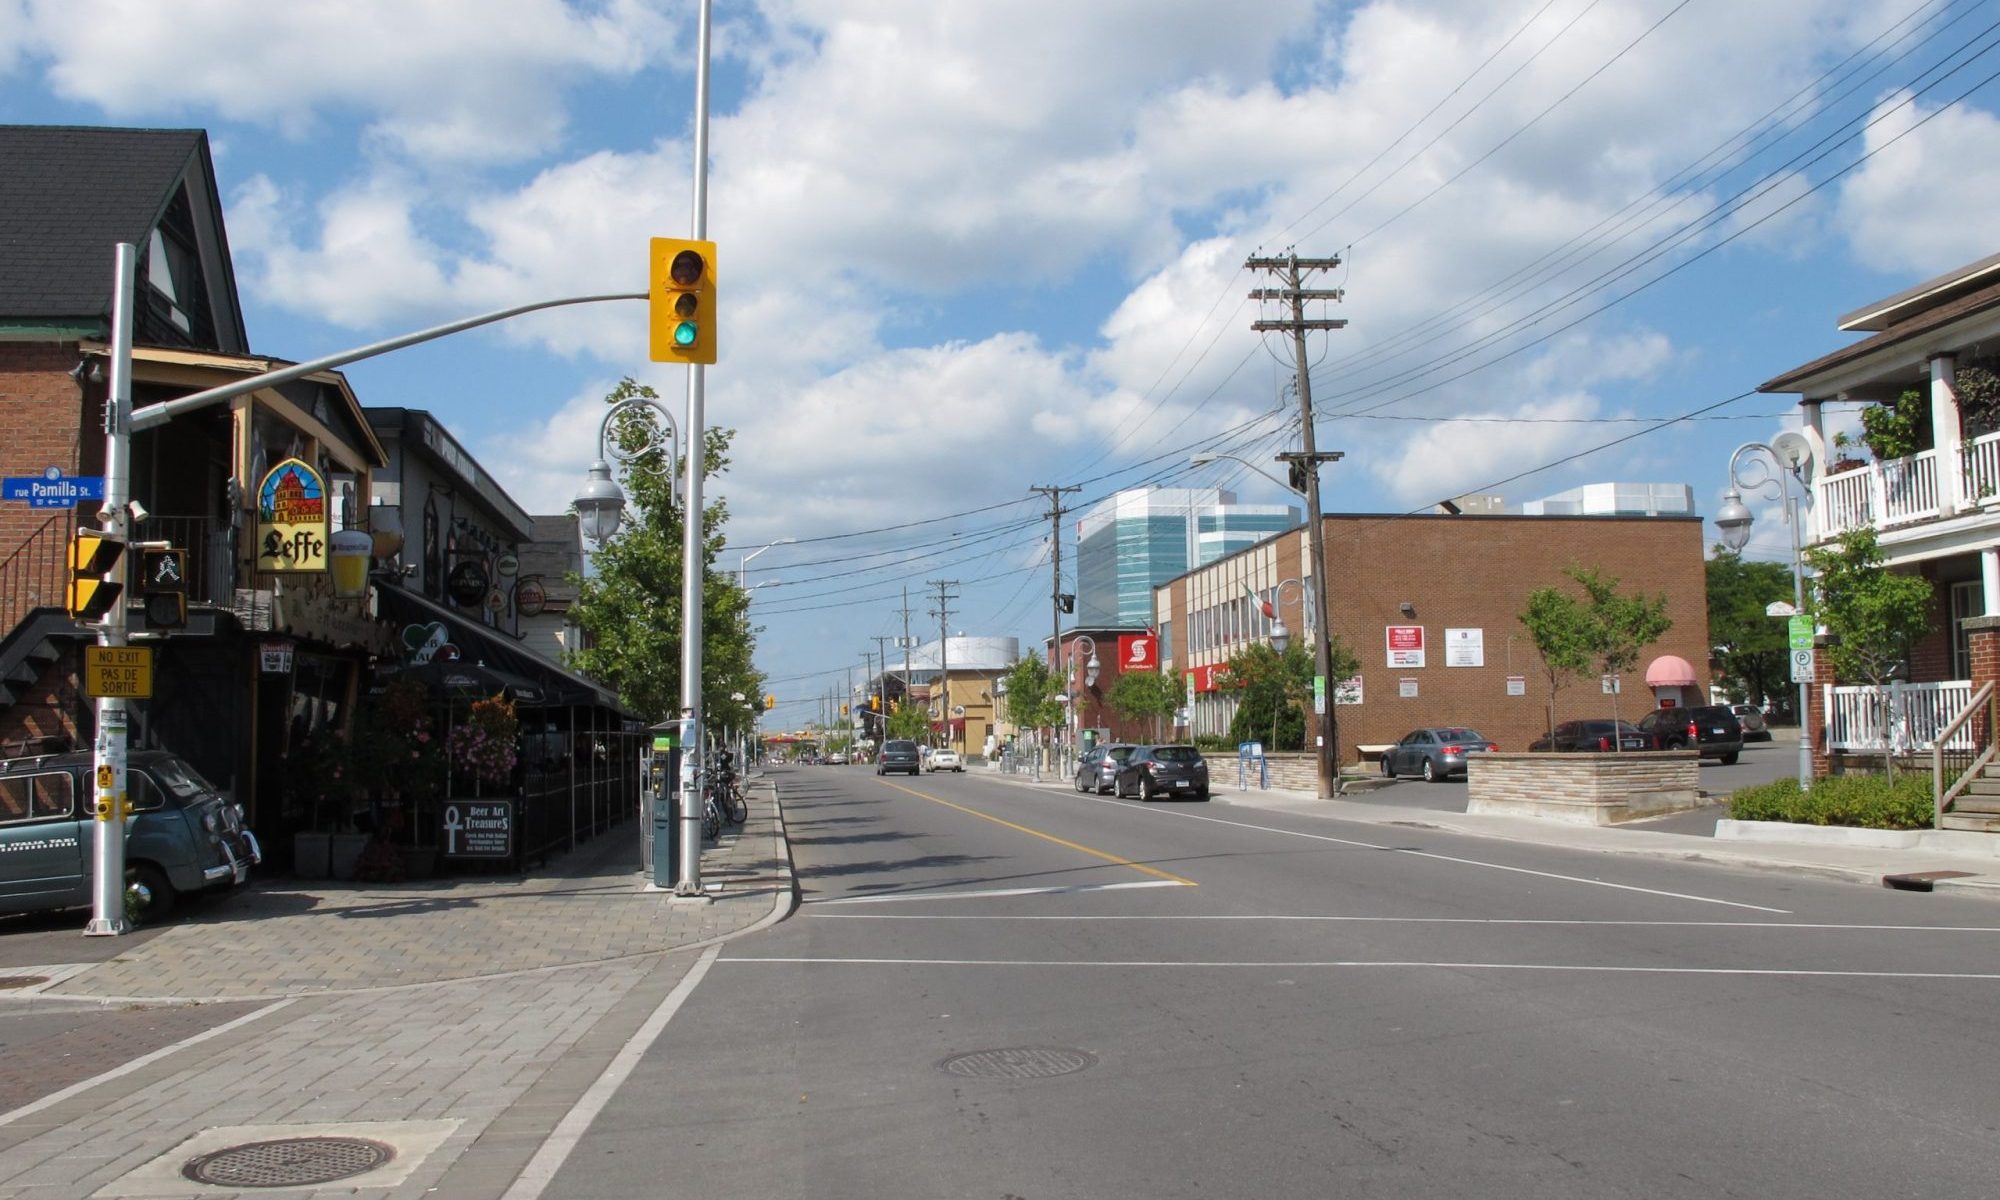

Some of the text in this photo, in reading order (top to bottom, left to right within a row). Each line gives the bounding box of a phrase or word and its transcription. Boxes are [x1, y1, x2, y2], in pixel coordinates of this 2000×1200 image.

[15, 481, 91, 497] rue Pamilla St.
[260, 529, 324, 564] Leffe
[99, 651, 140, 663] NO EXIT
[101, 668, 138, 681] PAS DE
[102, 681, 138, 694] SORTIE
[470, 806, 505, 817] Beer Art
